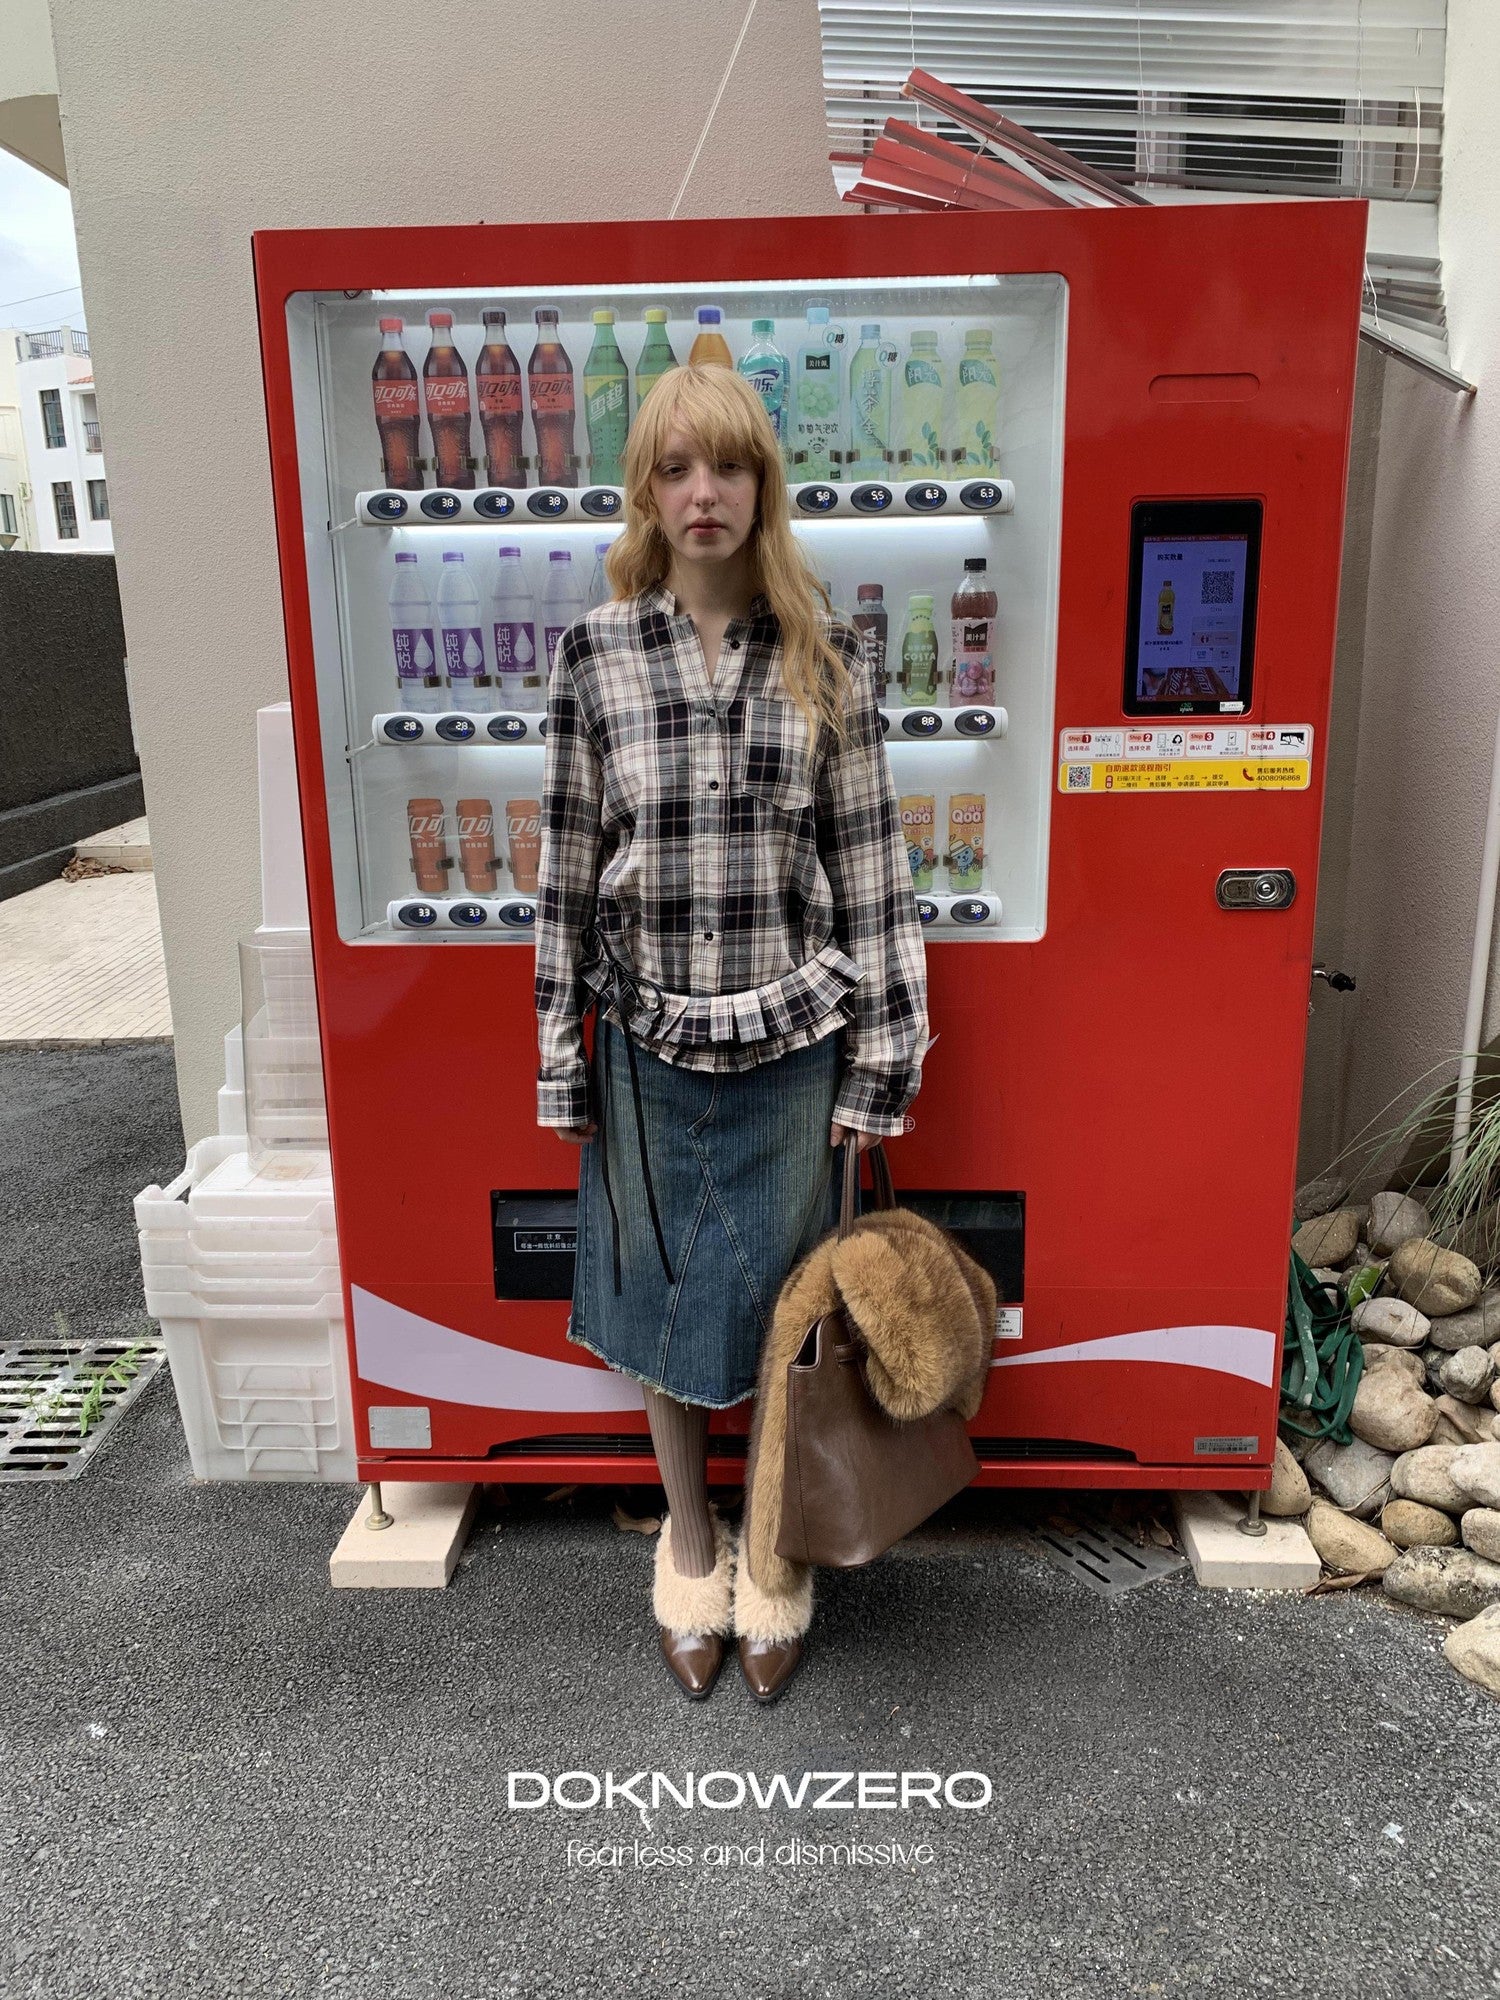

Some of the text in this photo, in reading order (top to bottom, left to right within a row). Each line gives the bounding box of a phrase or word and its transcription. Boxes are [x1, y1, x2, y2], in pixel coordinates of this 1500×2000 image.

[374, 384, 416, 403] 可口可乐
[426, 381, 467, 401] 可口可乐
[530, 380, 572, 398] 可口可乐
[590, 383, 625, 422] 雪碧
[396, 634, 412, 669] 纯悦
[446, 633, 461, 669] 纯悦
[497, 627, 512, 664] 纯悦
[904, 652, 936, 662] COSTA
[1106, 764, 1171, 772] 自助退款流程指引
[902, 810, 933, 825] Qoo
[952, 808, 983, 825] Qoo
